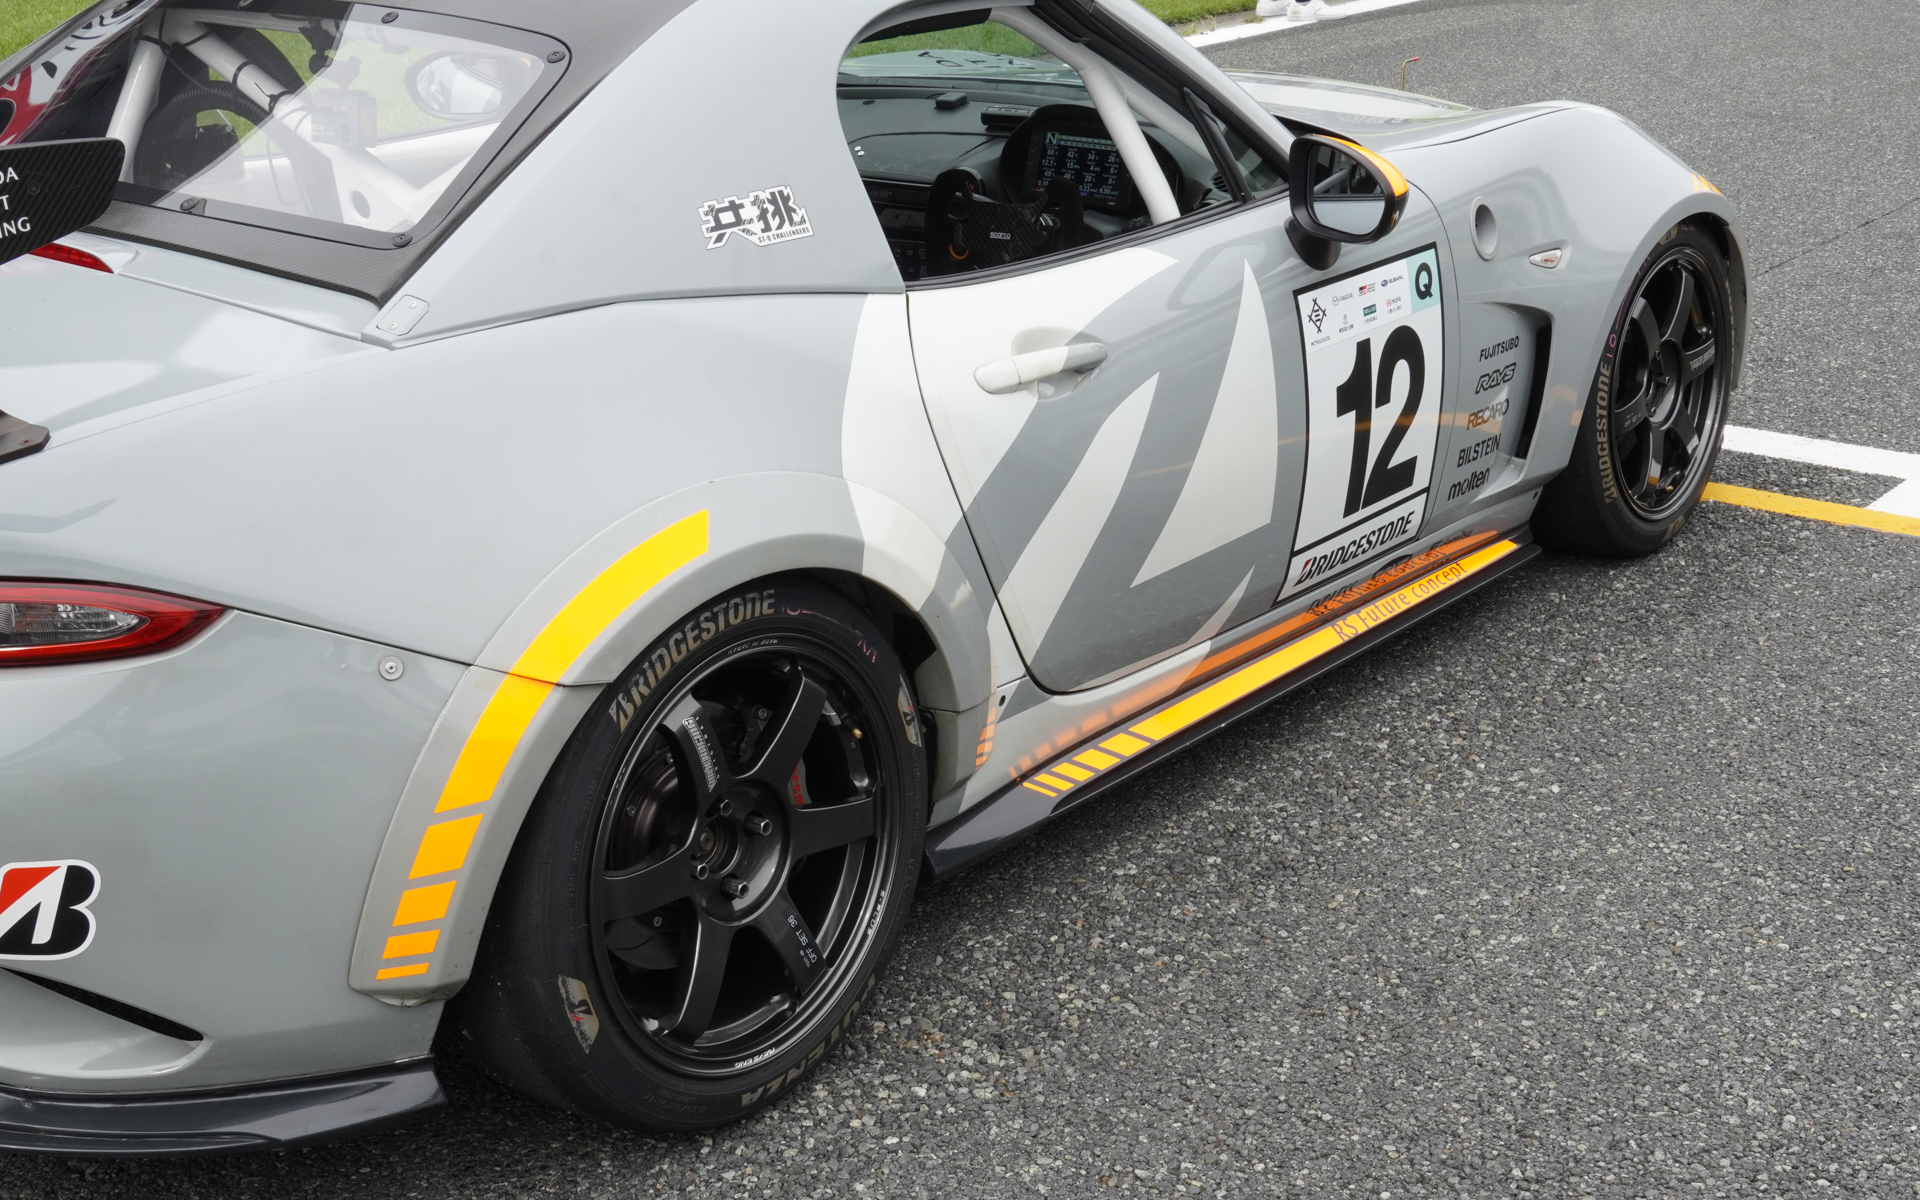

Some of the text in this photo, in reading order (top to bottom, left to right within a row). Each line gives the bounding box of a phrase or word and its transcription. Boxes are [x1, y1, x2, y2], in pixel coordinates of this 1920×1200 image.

[1046, 132, 1058, 145] N
[772, 226, 810, 241] CHALLENGERS
[1414, 261, 1434, 301] Q
[1478, 335, 1520, 363] FUJITSUBO
[1474, 361, 1517, 395] RAYS
[1336, 325, 1426, 519] 12
[1466, 398, 1510, 431] RECARO
[1595, 361, 1618, 504] BRIDGESTONE
[1456, 432, 1502, 469] BILSTEIN
[1447, 466, 1491, 501] molten
[1292, 510, 1416, 588] BRIDGESTONE
[1331, 616, 1359, 642] RS
[1358, 593, 1411, 628] Future
[1411, 562, 1467, 599] concept
[608, 588, 777, 734] BRIDGESTONE
[787, 914, 798, 928] 36
[795, 928, 809, 946] SET
[805, 947, 818, 963] OFF
